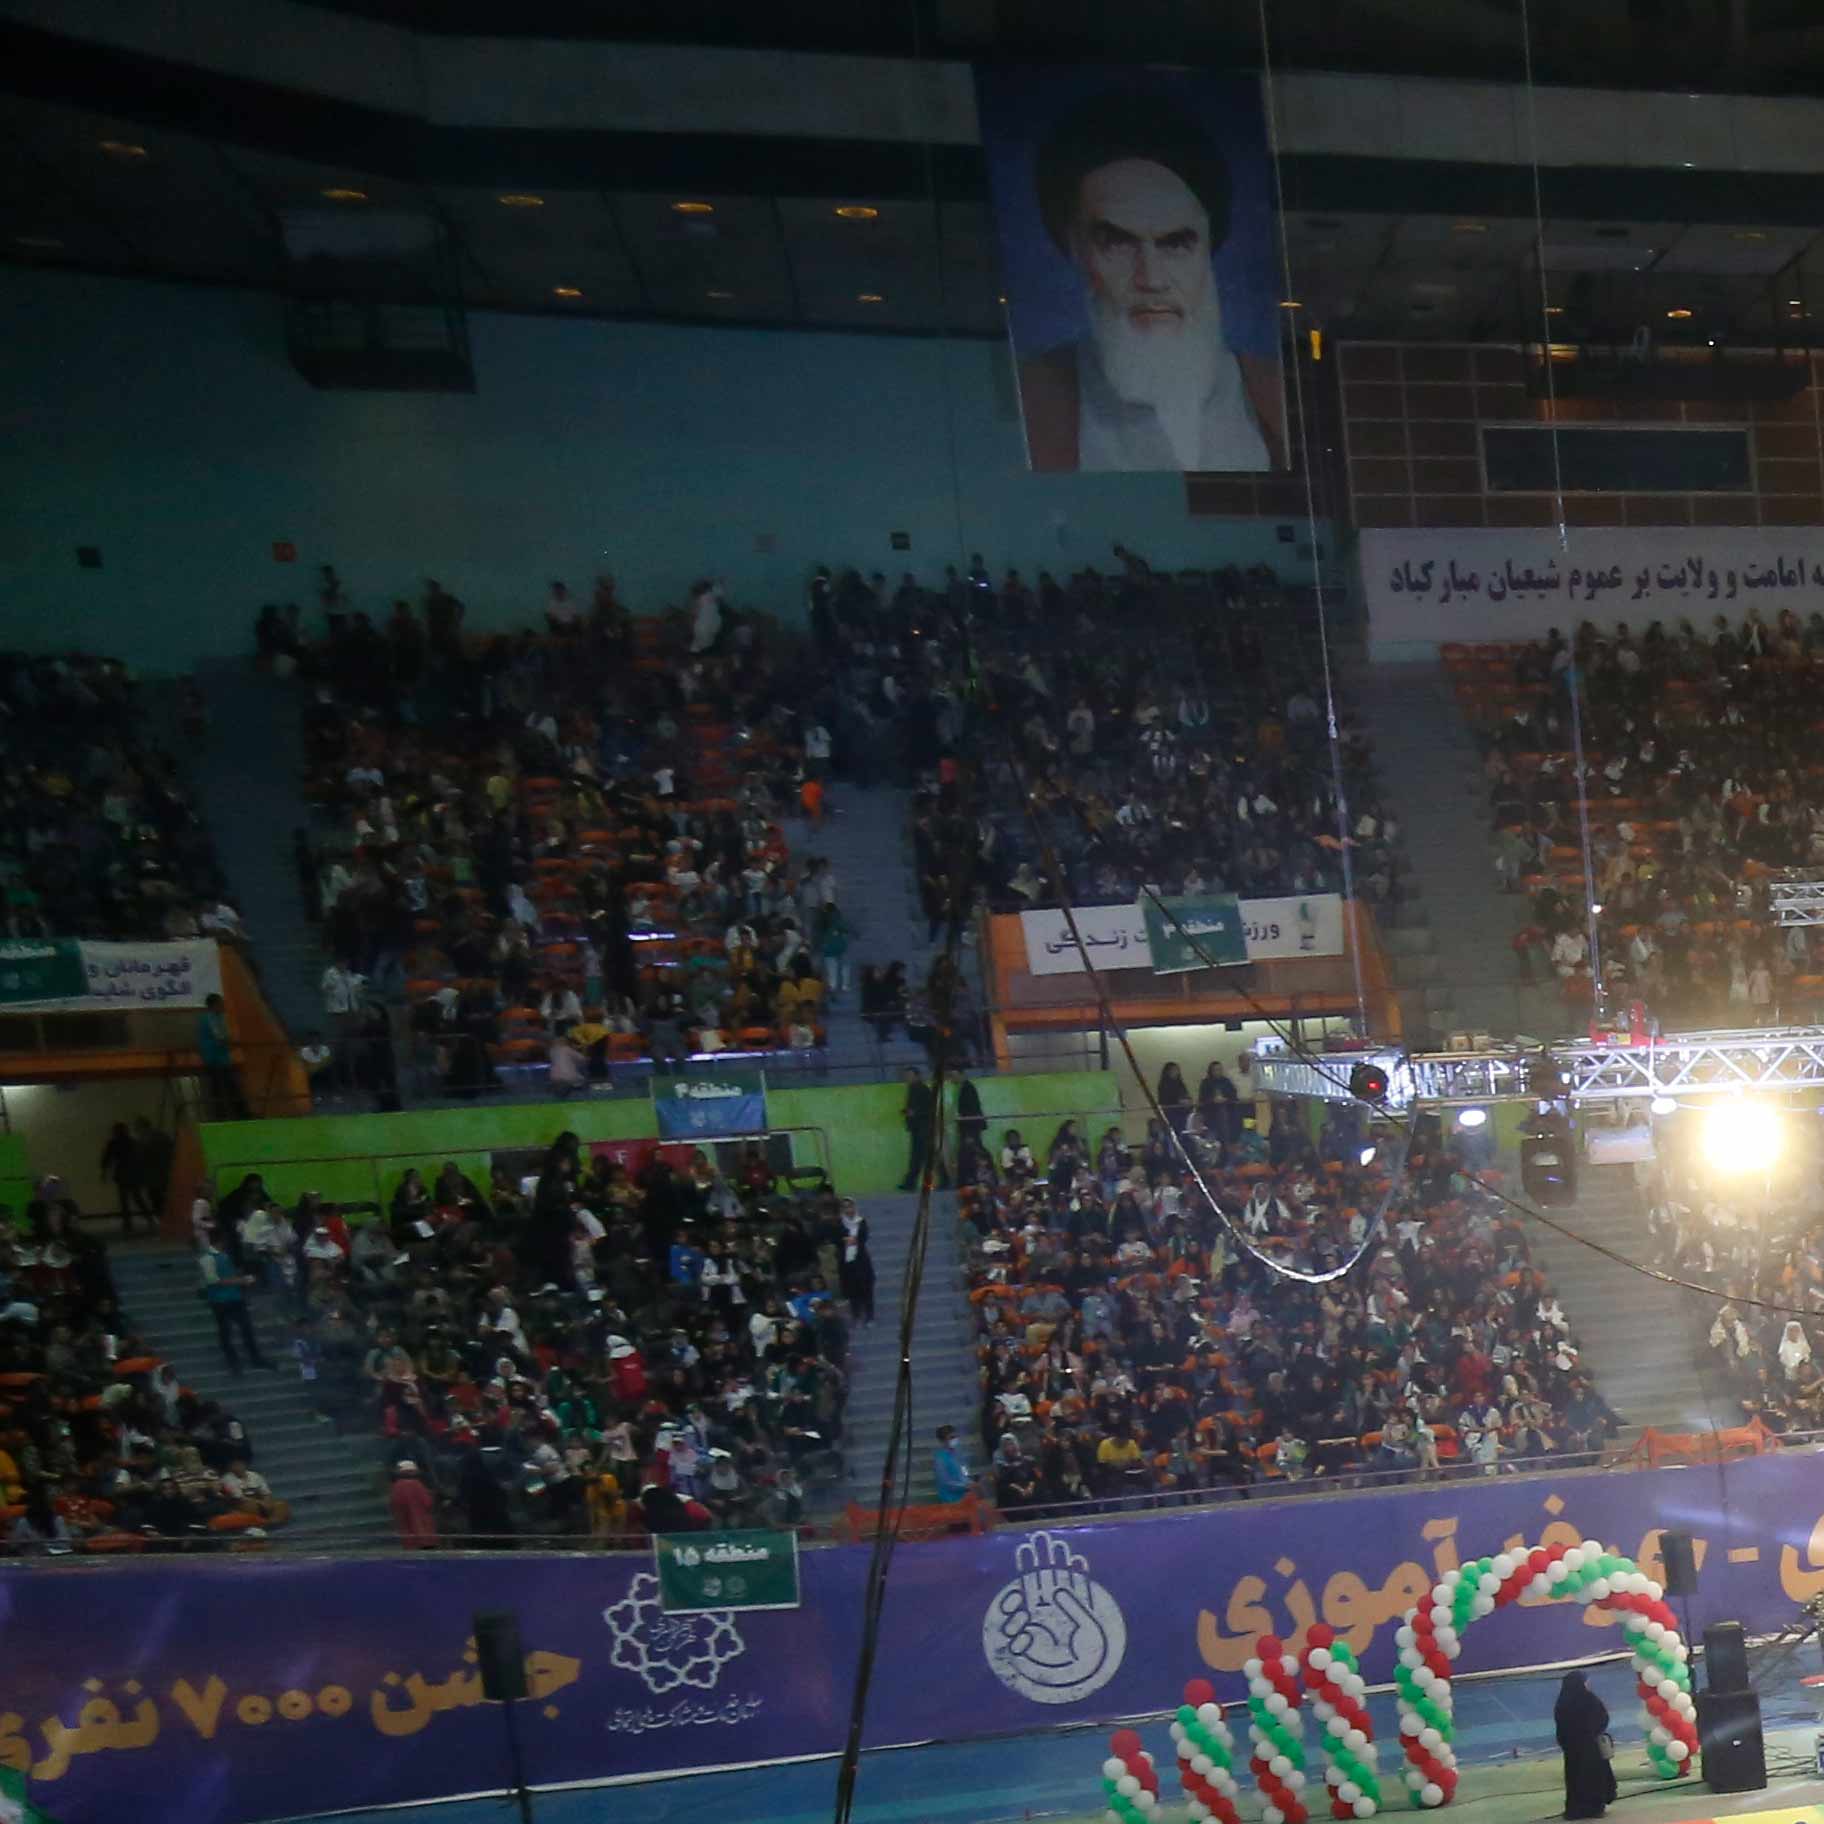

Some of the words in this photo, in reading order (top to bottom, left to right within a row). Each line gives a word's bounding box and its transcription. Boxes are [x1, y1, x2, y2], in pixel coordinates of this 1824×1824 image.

[1487, 559, 1561, 600] شیعیان
[1568, 564, 1623, 600] عموم
[1631, 567, 1651, 600] بر
[1656, 556, 1718, 599] ولایت
[1726, 569, 1737, 599] و
[1743, 556, 1805, 589] امامت
[690, 1081, 743, 1099] منطقه
[672, 1546, 700, 1567] ۱۵
[703, 1542, 770, 1563] منطقه
[1196, 1516, 1460, 1672] آموزی
[169, 1673, 354, 1740] ۷۰۰۰
